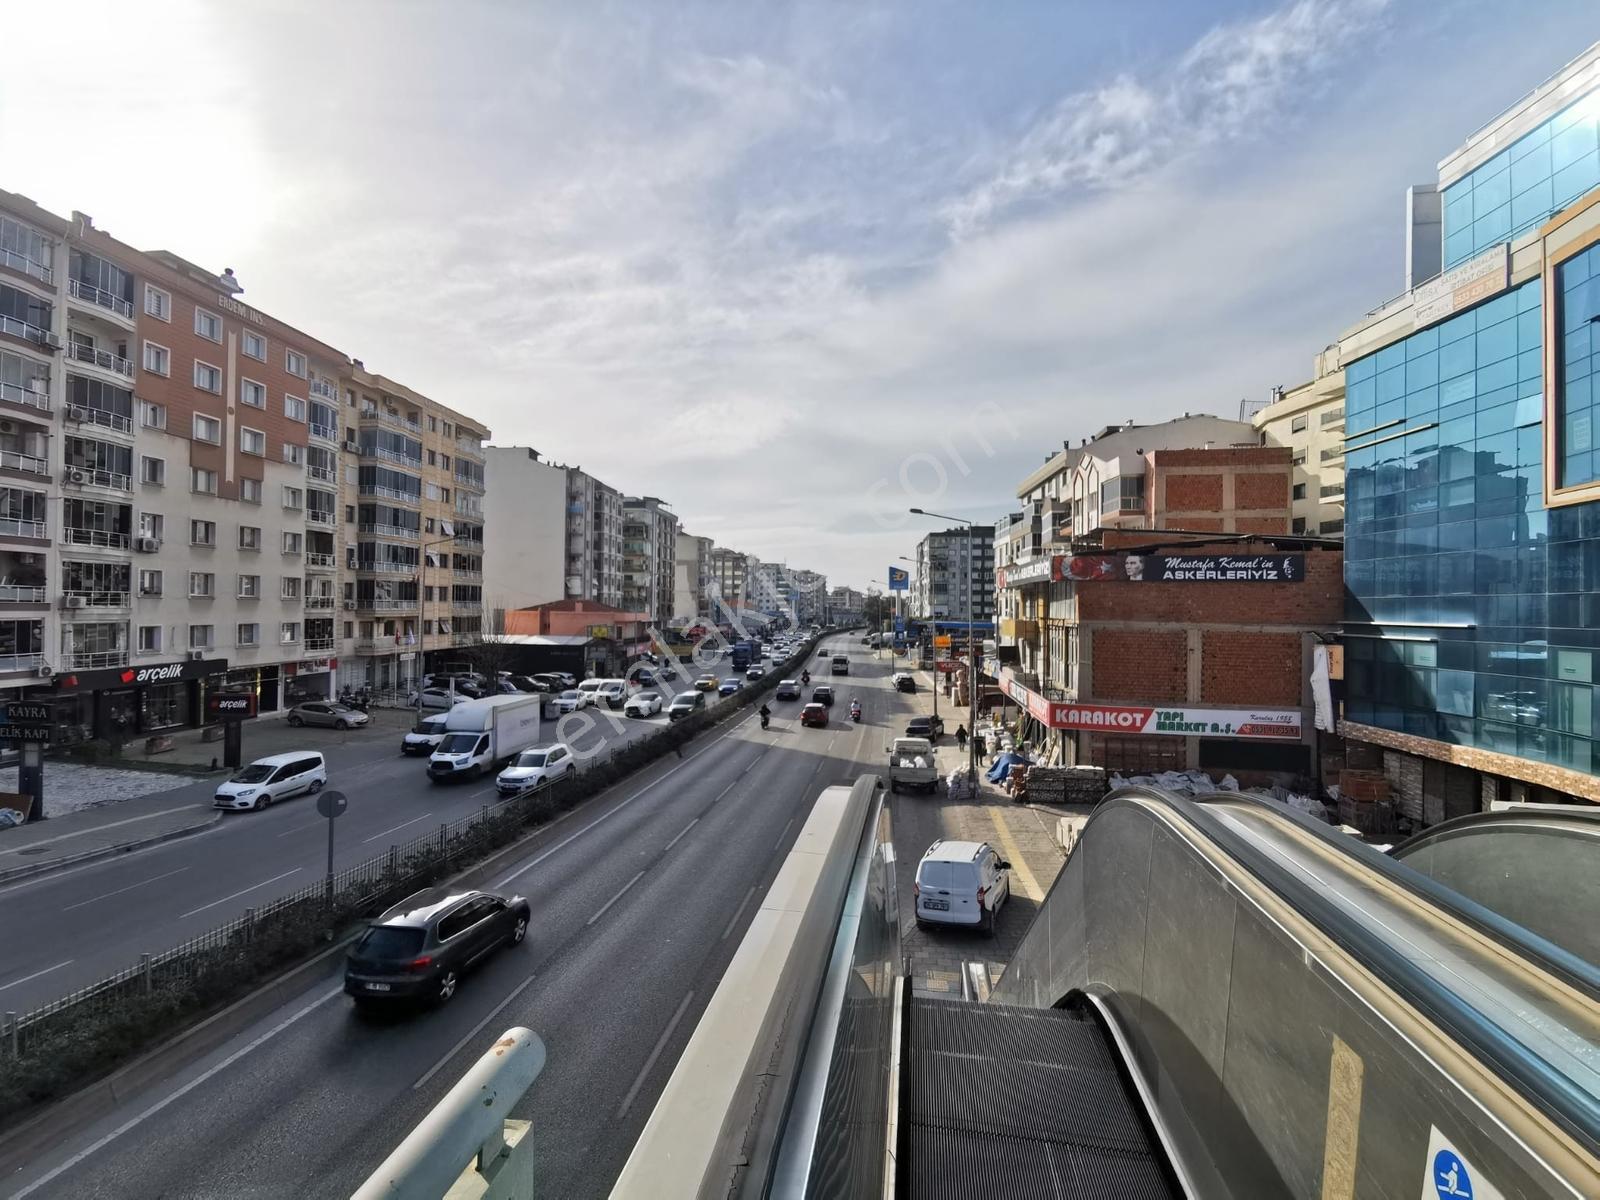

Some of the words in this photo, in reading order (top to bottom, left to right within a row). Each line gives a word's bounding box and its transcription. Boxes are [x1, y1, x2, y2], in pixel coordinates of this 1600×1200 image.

[1164, 557, 1215, 571] Mustafa
[1218, 557, 1273, 569] Kemal'in
[1163, 569, 1278, 580] ASKERLERİYİZ
[137, 664, 183, 683] arçelik
[219, 699, 248, 711] arçelik
[8, 706, 47, 718] KAYRA
[1055, 708, 1144, 727] KARAKOT
[1155, 711, 1184, 722] YAPI
[1156, 721, 1208, 733] MARKET
[24, 728, 49, 739] KAPI
